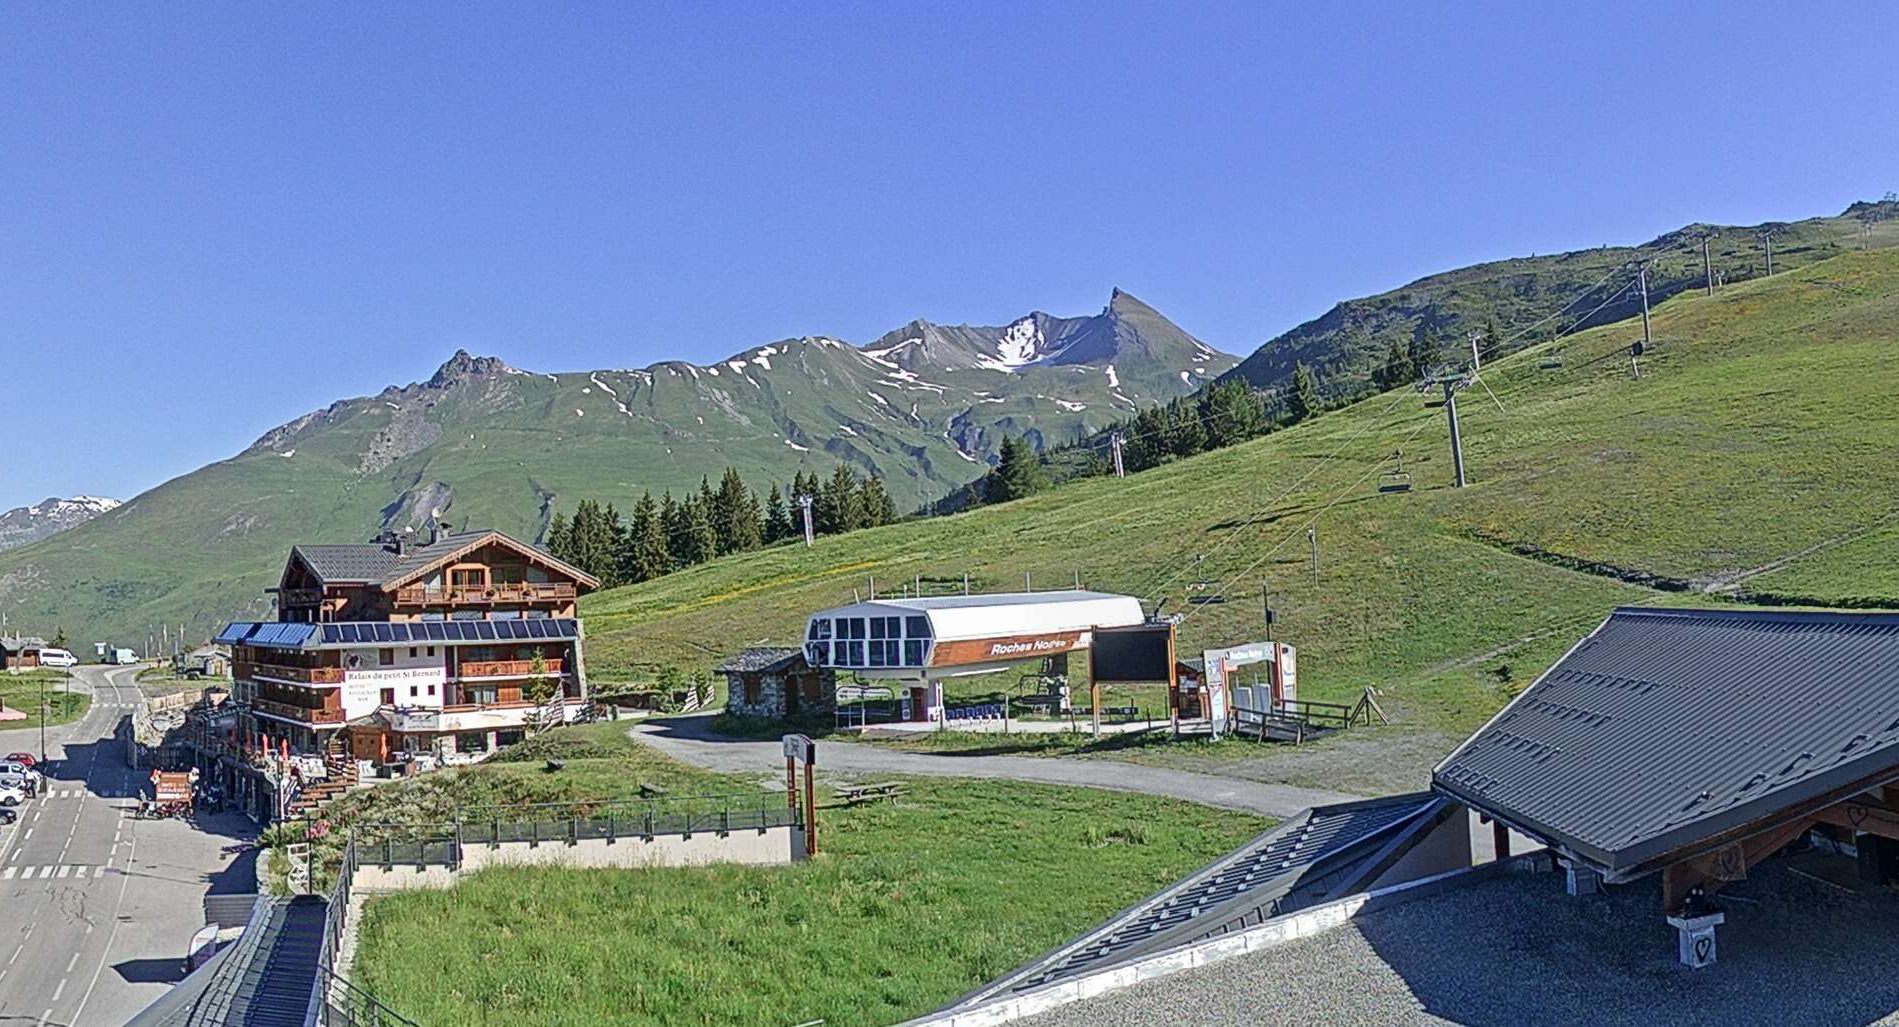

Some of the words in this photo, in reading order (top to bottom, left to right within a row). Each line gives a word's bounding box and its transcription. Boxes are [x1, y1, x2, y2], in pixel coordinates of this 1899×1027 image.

[990, 642, 1033, 656] Roches
[348, 672, 372, 681] Relais
[384, 672, 402, 681] petit
[412, 669, 441, 678] Bernard
